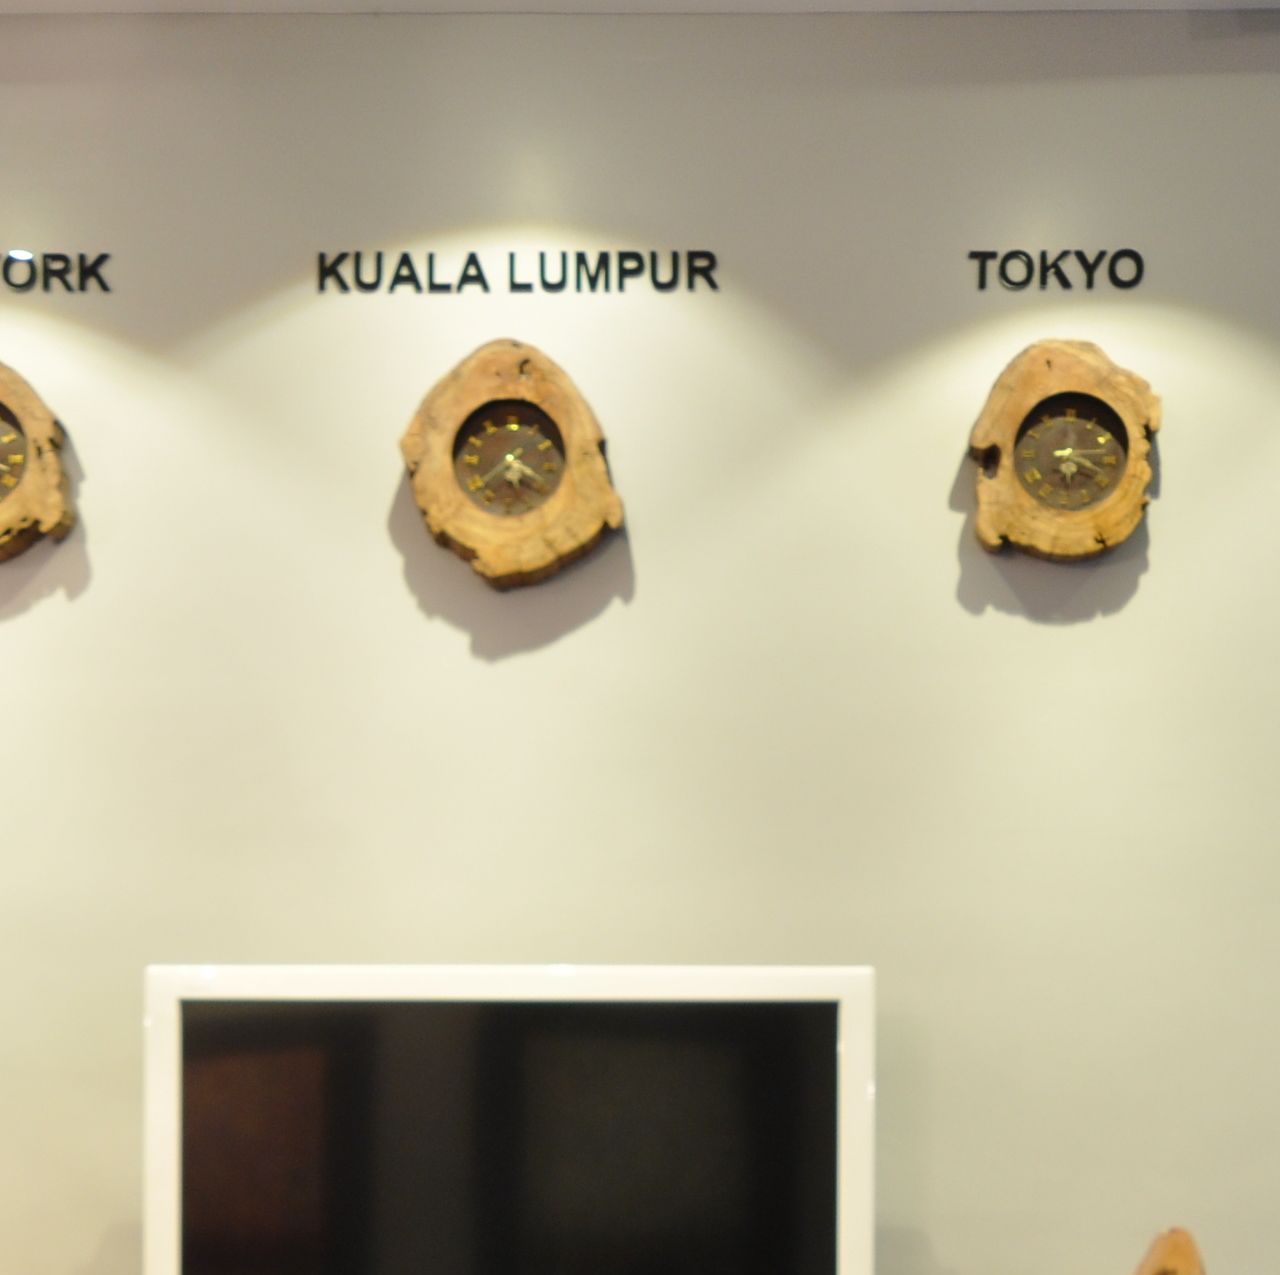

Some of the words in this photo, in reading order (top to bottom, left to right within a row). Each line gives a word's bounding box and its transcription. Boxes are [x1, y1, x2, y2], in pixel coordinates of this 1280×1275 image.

[318, 251, 490, 293] KUALA
[509, 251, 719, 293] LUMPUR
[968, 249, 1145, 290] TOKYO
